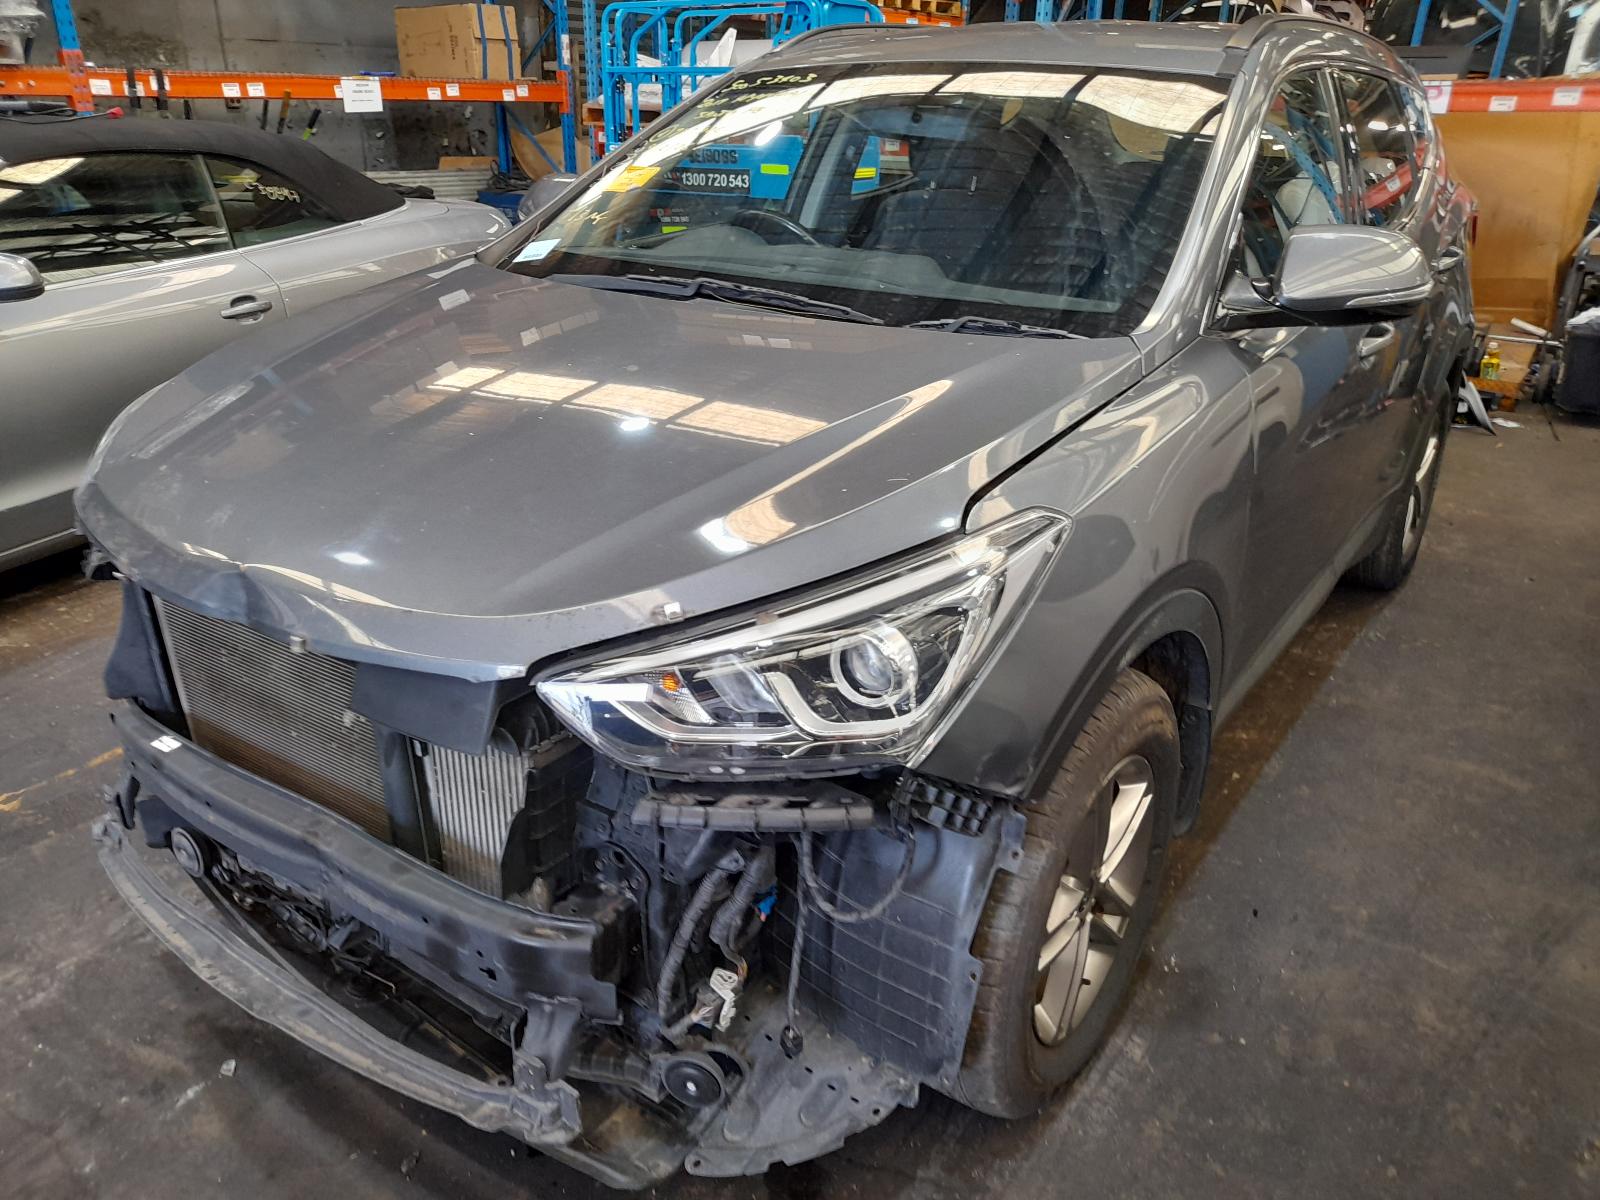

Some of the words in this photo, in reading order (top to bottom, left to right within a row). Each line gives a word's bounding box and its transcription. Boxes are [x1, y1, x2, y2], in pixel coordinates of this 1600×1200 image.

[681, 172, 706, 186] 1300
[707, 173, 728, 187] 720
[729, 174, 750, 188] 543
